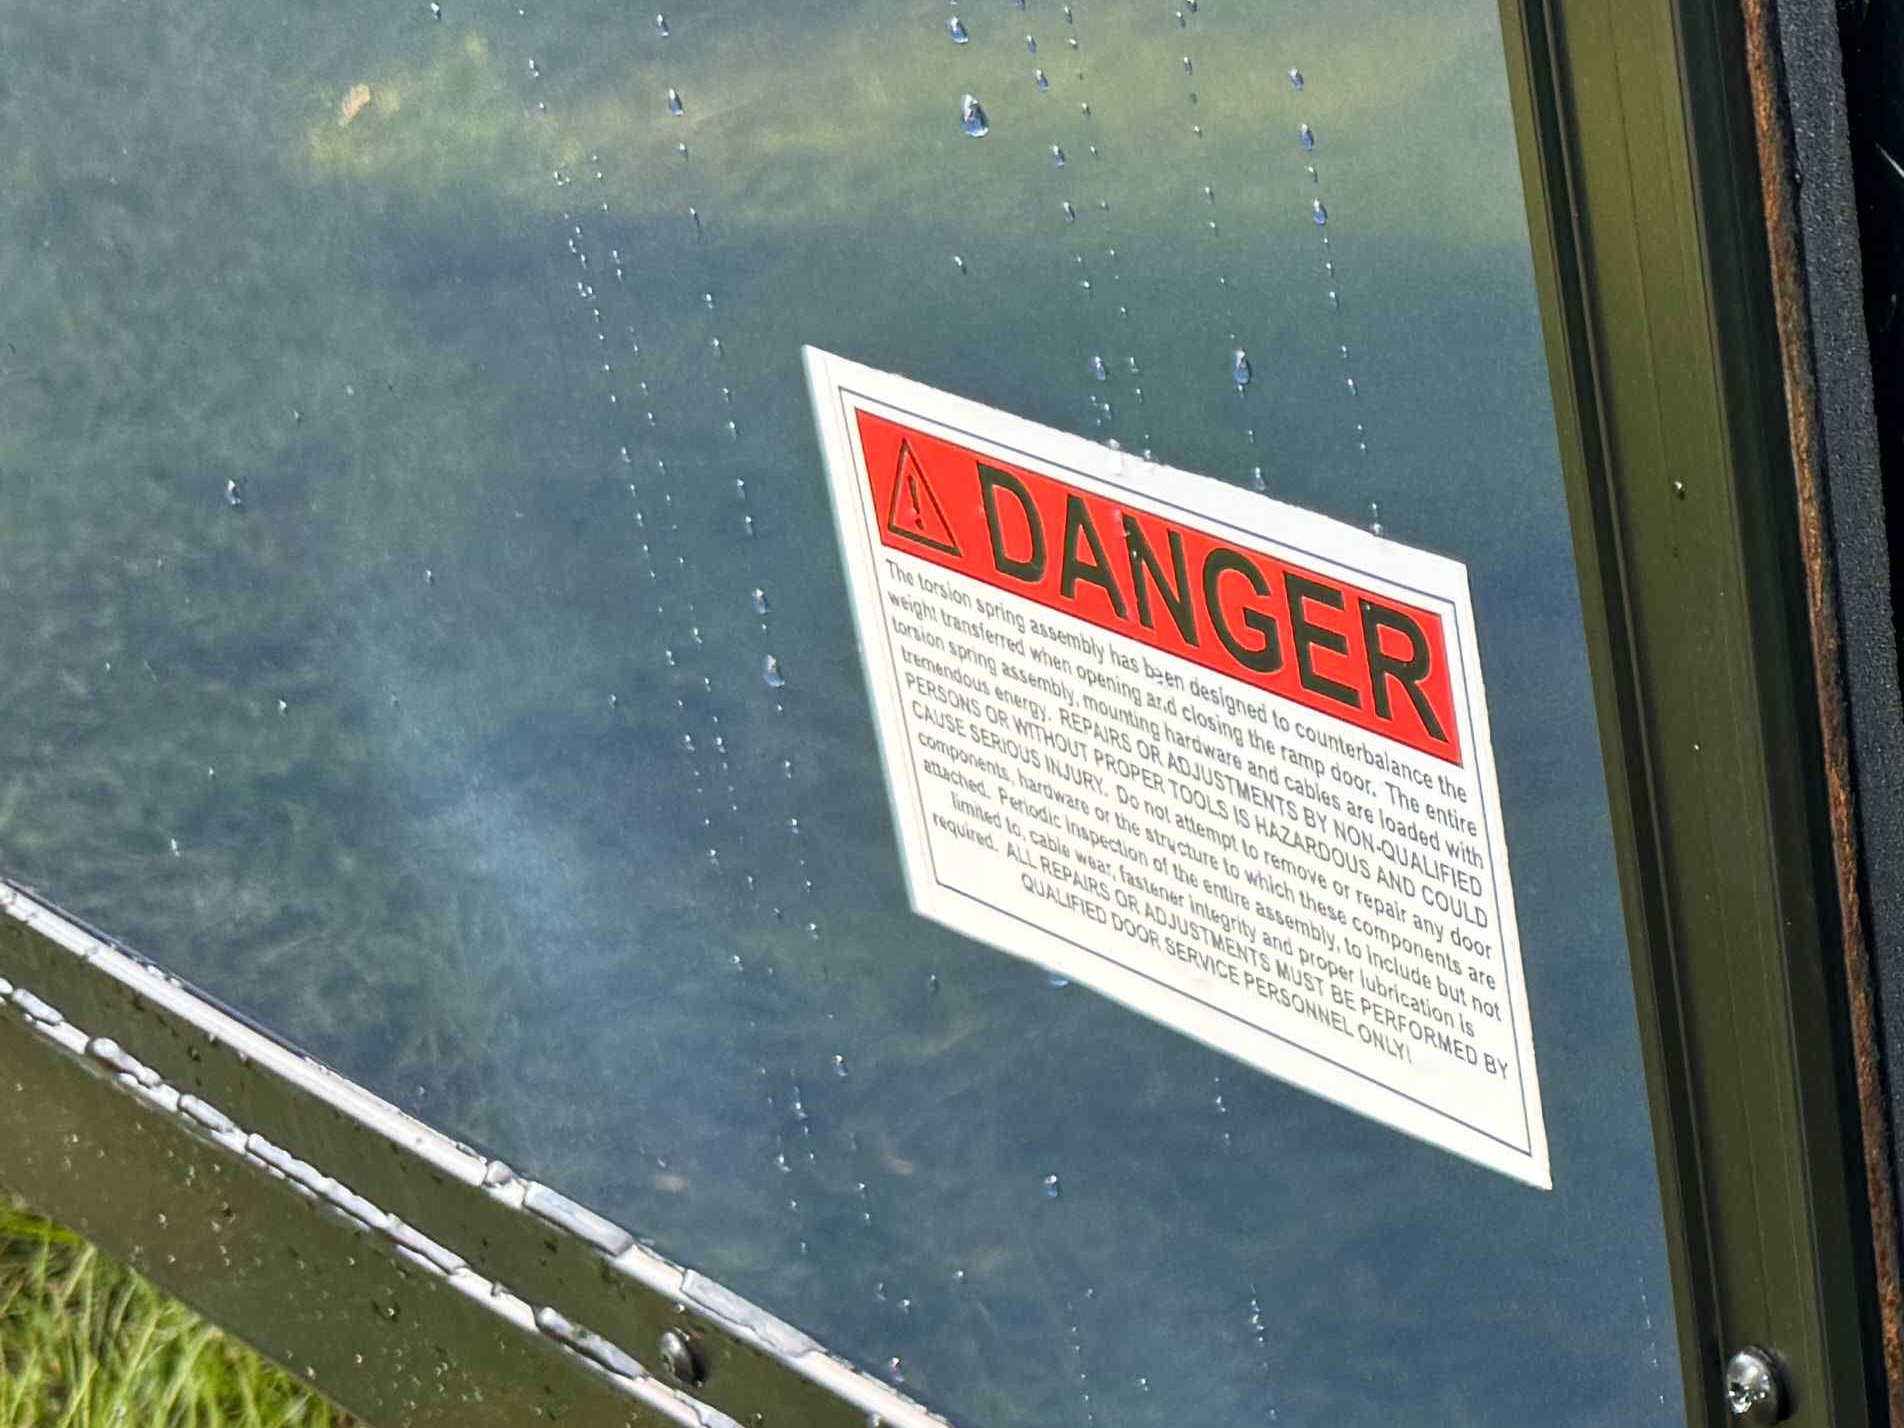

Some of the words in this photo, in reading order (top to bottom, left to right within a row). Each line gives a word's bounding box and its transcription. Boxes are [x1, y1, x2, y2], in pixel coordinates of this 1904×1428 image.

[884, 557, 915, 586] The
[916, 572, 972, 609] torsion
[974, 597, 1026, 634] spring
[1028, 618, 1105, 665] assembly
[1108, 643, 1140, 674] has
[1141, 656, 1185, 692] been
[1188, 677, 1268, 725] designed
[1271, 708, 1291, 733] to
[1294, 721, 1434, 790] counterbalance
[1436, 774, 1468, 804] the
[887, 590, 938, 623] weight
[939, 607, 1026, 657] transferred
[1028, 645, 1073, 675] when
[1075, 664, 1143, 708] opening
[1145, 691, 1178, 717] and
[1181, 705, 1244, 749] closing
[1246, 728, 1276, 756] the
[1279, 744, 1326, 779] ramp
[1387, 783, 1420, 814] The
[1424, 802, 1478, 837] entire
[977, 460, 1447, 743] DANGER
[890, 615, 945, 652] torsion
[947, 640, 998, 677] spring
[1081, 693, 1161, 743] mounting
[1162, 721, 1243, 771] hardware
[1246, 759, 1280, 786] and
[1283, 775, 1342, 812] cables
[1345, 800, 1375, 825] are
[1377, 808, 1441, 853] loaded
[1444, 839, 1484, 870] with
[900, 643, 991, 696] tremendous
[1058, 706, 1133, 754] REPAIRS
[1135, 738, 1164, 767] OR
[1166, 751, 1299, 822] ADJUSTMENTS
[1302, 806, 1328, 834] BY
[1332, 818, 1483, 898] NON-QUALIFIED
[904, 671, 982, 718] PERSONS
[984, 703, 1010, 730] OR
[1011, 714, 1088, 763] WITHOUT
[1092, 747, 1166, 795] PROPER
[1167, 777, 1230, 821] TOOLS
[1232, 804, 1251, 829] IS
[1253, 813, 1372, 880] HAZARDOUS
[1376, 865, 1416, 898] AND
[1420, 883, 1488, 929] COULD
[911, 699, 967, 738] CAUSE
[968, 722, 1041, 769] SERIOUS
[1115, 783, 1140, 811] Do
[1143, 799, 1171, 824] not
[1174, 812, 1239, 853] attempt
[1240, 837, 1259, 861] to
[1262, 849, 1328, 890] remove
[1331, 879, 1351, 900] or
[1355, 889, 1407, 923] repair
[1411, 913, 1444, 944] any
[1449, 926, 1492, 960] door
[950, 790, 1002, 829] limited
[1028, 829, 1071, 859] cable
[1118, 863, 1185, 908] fastener
[1187, 893, 1257, 944] integrity
[1261, 930, 1294, 957] and
[1297, 946, 1355, 983] proper
[1359, 968, 1455, 1029] lubrication
[1458, 1012, 1476, 1038] is
[997, 785, 1062, 829] Periodic
[1064, 814, 1149, 867] inspection
[1152, 856, 1169, 876] of
[1171, 862, 1199, 889] the
[1201, 878, 1251, 911] entire
[1343, 936, 1362, 960] to
[1365, 944, 1432, 990] include
[1435, 974, 1468, 1007] but
[1471, 994, 1502, 1023] not
[1006, 840, 1038, 870] ALL
[1039, 854, 1111, 902] REPAIRS
[1113, 888, 1141, 915] OR
[1144, 901, 1271, 973] ADJUSTMENTS
[1274, 958, 1324, 997] MUST
[1329, 983, 1357, 1012] BE
[1359, 996, 1478, 1066] PERFORMED
[1482, 1051, 1509, 1080] BY
[1016, 767, 1090, 816] hardware
[1093, 805, 1110, 824] or
[1113, 811, 1141, 837] the
[1144, 827, 1219, 871] structure
[1222, 856, 1240, 880] to
[1243, 869, 1296, 904] which
[1298, 889, 1348, 926] these
[1351, 915, 1463, 976] components
[1467, 965, 1496, 991] are
[1020, 871, 1107, 925] QUALIFIED
[1110, 911, 1162, 951] DOOR
[1163, 935, 1241, 986] SERVICE
[1242, 969, 1355, 1038] PERSONNEL
